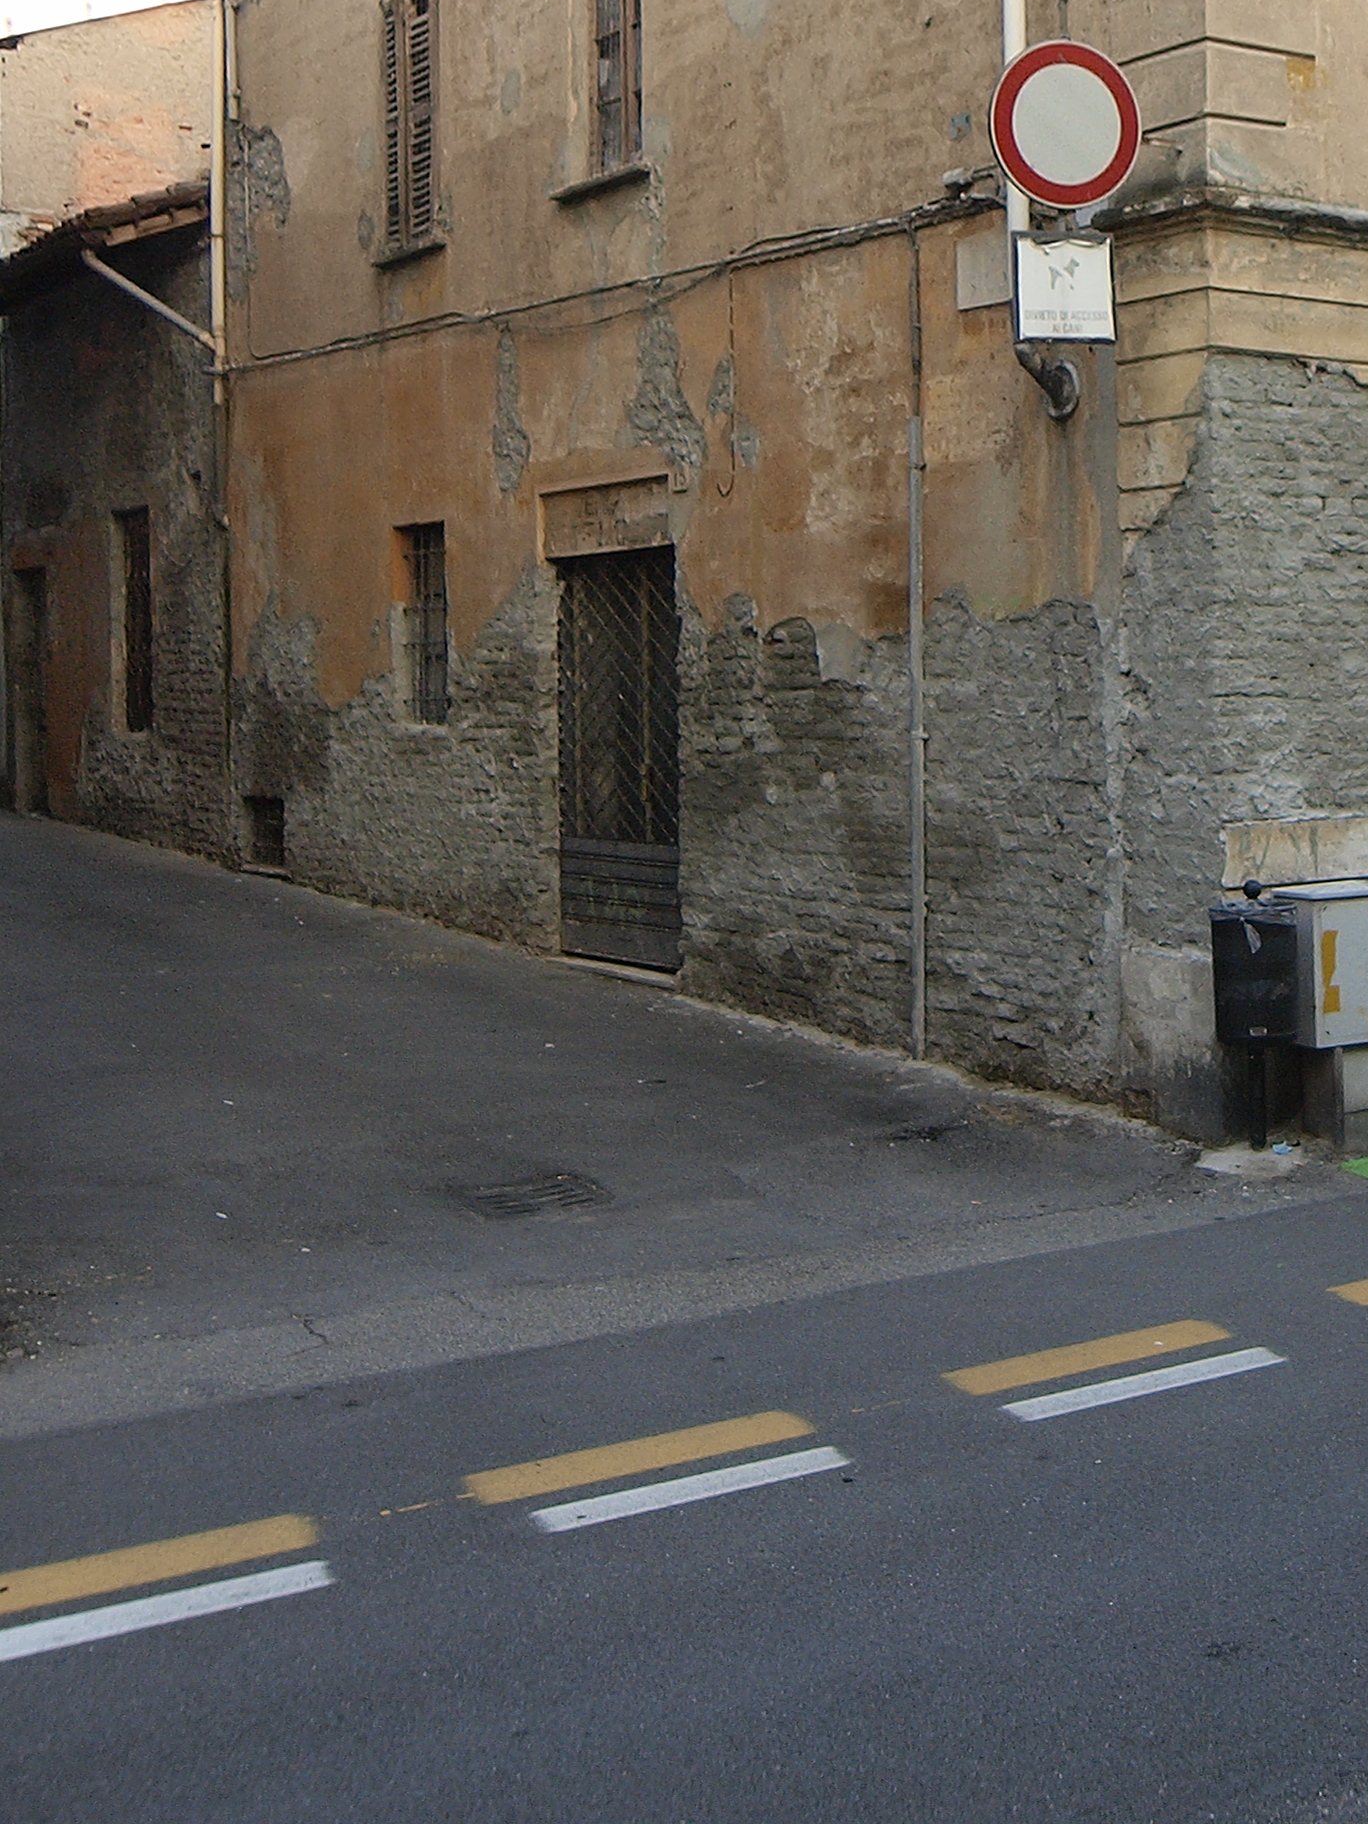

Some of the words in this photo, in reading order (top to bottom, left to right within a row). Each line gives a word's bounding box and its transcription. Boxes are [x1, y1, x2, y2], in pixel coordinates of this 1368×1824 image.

[1024, 310, 1057, 321] DIVIETO
[1059, 310, 1068, 320] DI
[1071, 310, 1108, 321] ACCESSO
